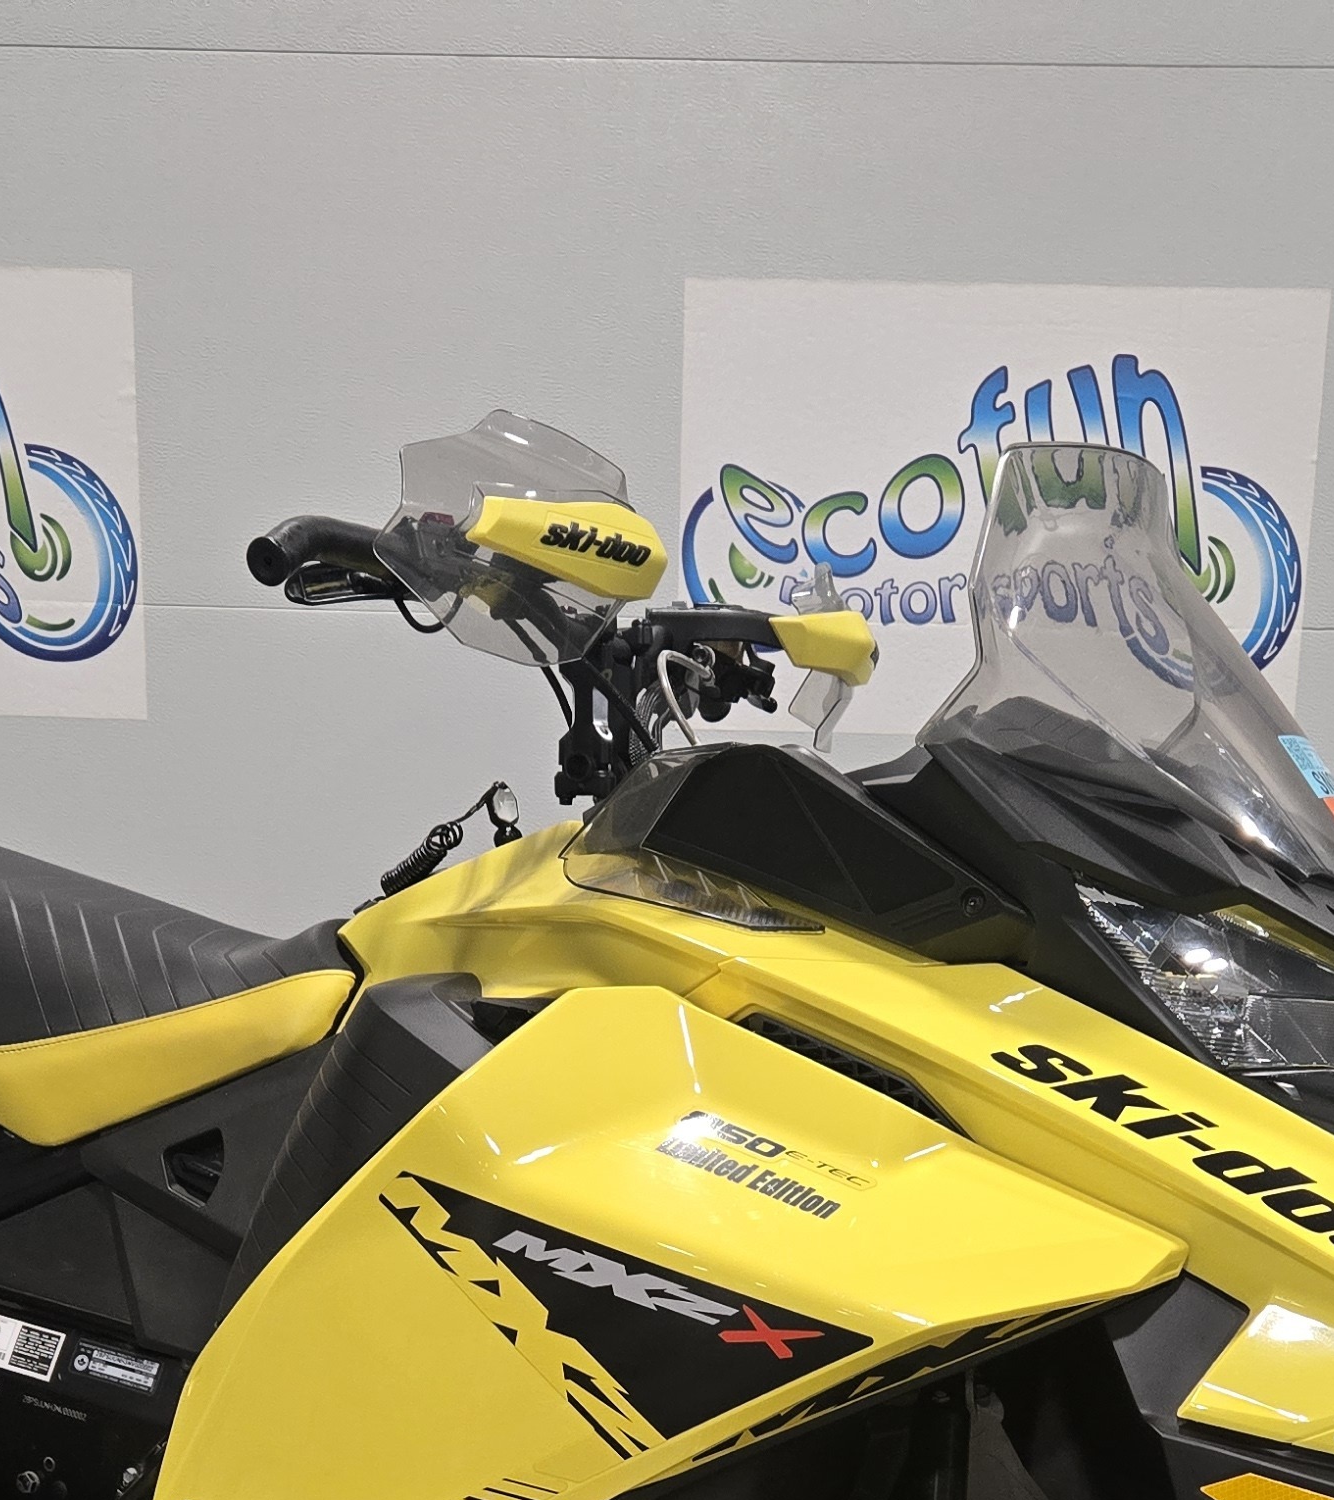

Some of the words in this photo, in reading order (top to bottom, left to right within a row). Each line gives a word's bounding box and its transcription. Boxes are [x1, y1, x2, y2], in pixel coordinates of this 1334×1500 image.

[540, 521, 651, 567] ski-doo
[785, 1150, 870, 1187] E-TEC
[745, 1169, 841, 1219] Edition
[492, 1230, 739, 1325] MXZ
